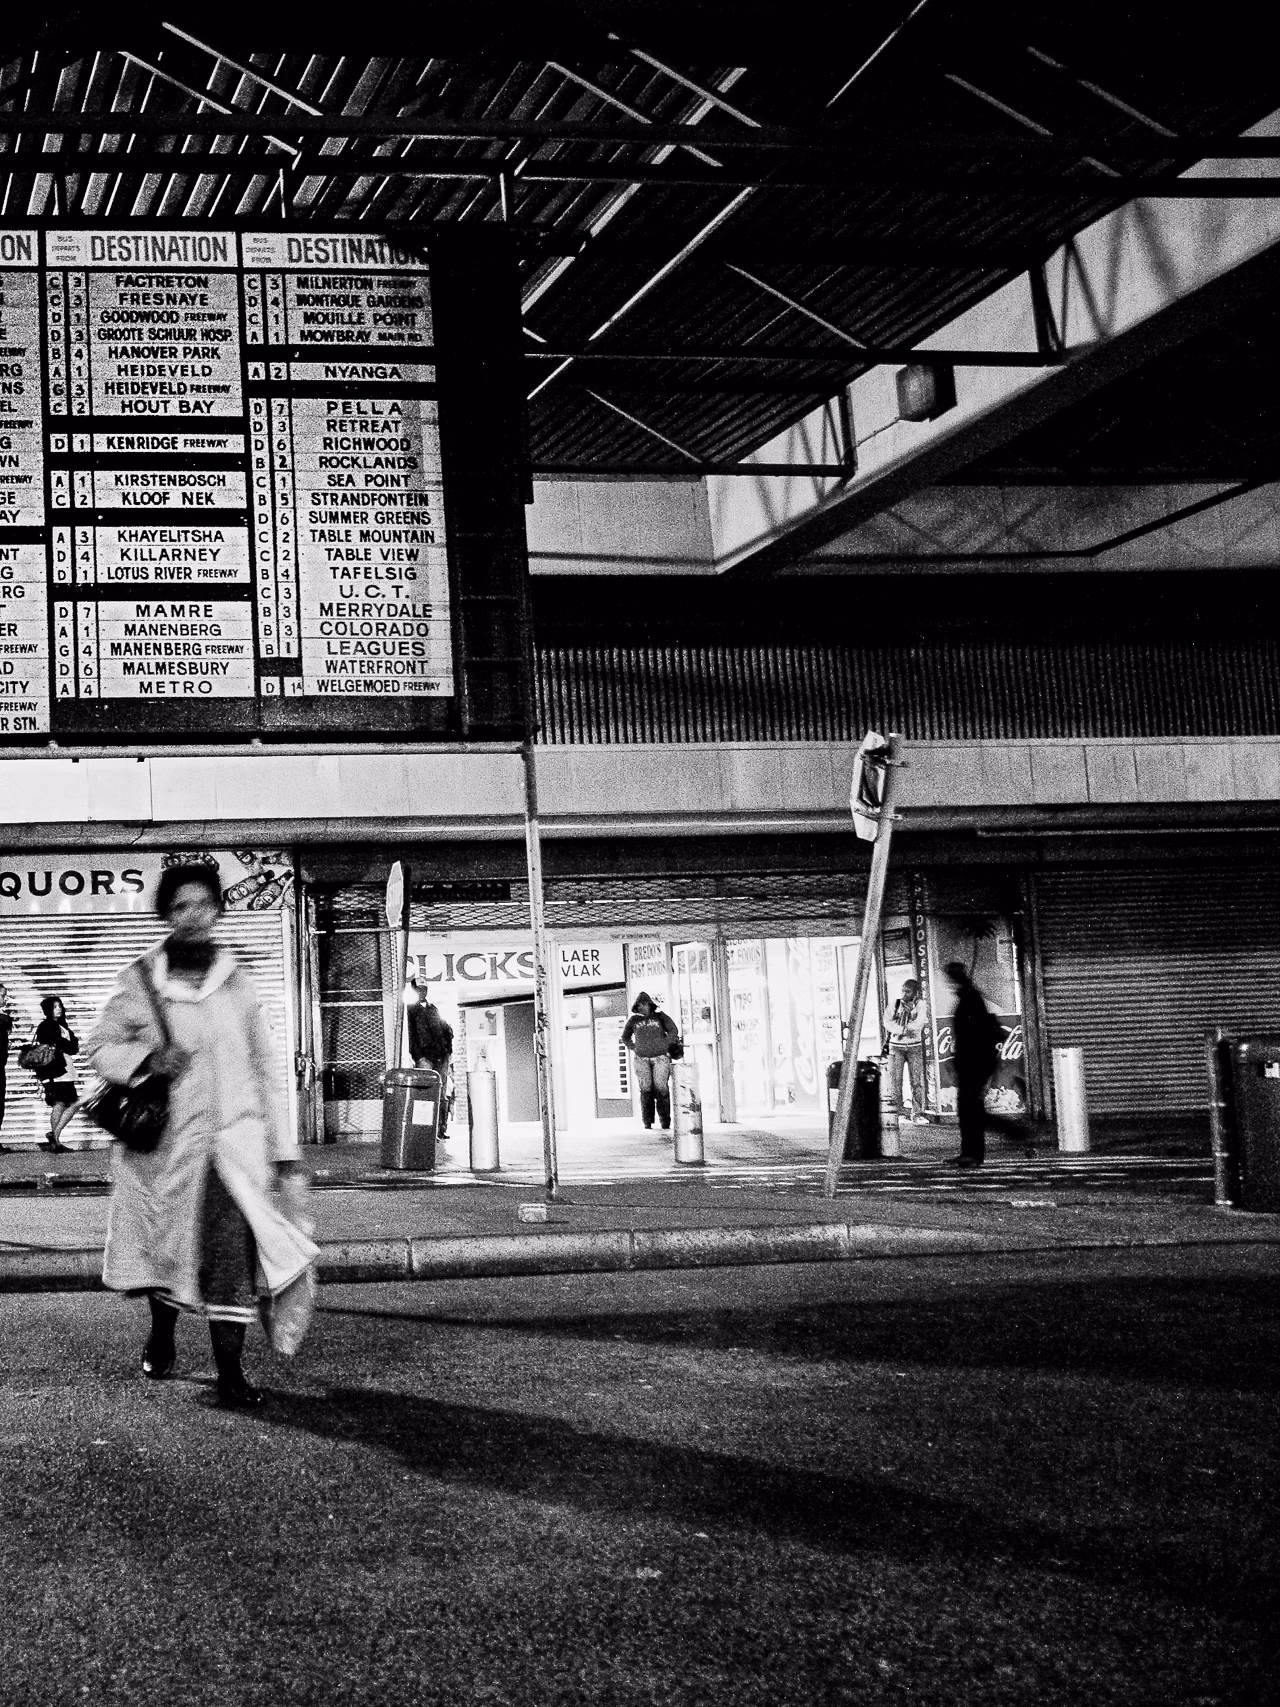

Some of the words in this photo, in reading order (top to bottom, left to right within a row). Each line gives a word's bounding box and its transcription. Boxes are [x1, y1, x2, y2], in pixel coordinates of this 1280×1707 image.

[91, 236, 228, 262] DESTINATION
[116, 276, 208, 288] FACTRETON
[297, 277, 373, 289] MILNERTON
[119, 293, 208, 306] FRESNAYE
[296, 294, 361, 307] MONTAGUE
[367, 295, 424, 308] GARDENS
[100, 310, 179, 324] GOODWOOD
[304, 312, 365, 324] MOUILLE
[373, 313, 417, 325] POINT
[98, 328, 144, 341] GROOTE
[148, 328, 197, 341] SCHUUR
[300, 330, 371, 342] MOWBRAY
[109, 346, 177, 359] HANOVER
[183, 347, 220, 359] PARK
[118, 365, 212, 377] HEIDEVELD
[325, 366, 402, 379] NYANGA
[105, 382, 187, 395] HEIDEVELD
[54, 404, 62, 413] C
[77, 404, 84, 412] 2
[121, 400, 170, 413] HOUT
[179, 400, 214, 413] BAY
[327, 402, 402, 415] PELLA
[327, 420, 401, 432] RETREAT
[107, 436, 178, 449] KENRIDGE
[184, 439, 228, 448] FREEWAY
[323, 437, 411, 450] RICHWOOD
[320, 457, 418, 469] ROCKLANDS
[115, 474, 226, 487] KIRSTENBOSCH
[328, 474, 355, 487] SEA
[365, 474, 410, 487] POINT
[122, 492, 170, 505] KLOOF
[182, 492, 215, 505] NEK
[311, 493, 428, 506] STRANDFONTEIN
[258, 514, 268, 524] D
[280, 513, 289, 524] 6
[309, 511, 368, 524] SUMMER
[375, 511, 431, 524] GREENS
[57, 533, 64, 543] A
[80, 531, 88, 543] 3
[118, 530, 224, 543] KHAYELITSHA
[310, 530, 351, 543] TABLE
[360, 530, 435, 543] MOUNTAIN
[120, 548, 220, 561] KILLARNEY
[260, 551, 270, 561] C
[282, 551, 291, 560] 2
[325, 548, 371, 561] TABLE
[380, 548, 419, 561] VIEW
[108, 567, 149, 580] LOTUS
[154, 567, 192, 580] RIVER
[198, 569, 238, 578] FREEWAY
[261, 570, 269, 579] B
[281, 569, 289, 579] 4
[330, 567, 416, 580] TAFELSIG
[59, 607, 68, 617] D
[84, 608, 90, 617] 7
[136, 605, 213, 617] MAMRE
[320, 604, 433, 618] MERRYDALE
[124, 624, 221, 636] MANENBERG
[320, 622, 429, 637] COLORADO
[111, 643, 202, 656] MANENBERG
[205, 645, 244, 654] FREEWAY
[327, 641, 425, 655] LEAGUES
[60, 665, 69, 675] D
[84, 664, 92, 675] 6
[123, 662, 229, 675] MALMESBURY
[325, 660, 428, 674] WATERFRONT
[61, 685, 69, 695] A
[84, 685, 92, 695] 4
[139, 681, 212, 694] METRO
[317, 680, 399, 693] WELGEMOED
[403, 682, 440, 691] FREEWAY
[0, 702, 38, 711] FREEWAY
[13, 718, 39, 730] STN.
[562, 949, 600, 962] LAER
[561, 964, 601, 977] VLAK
